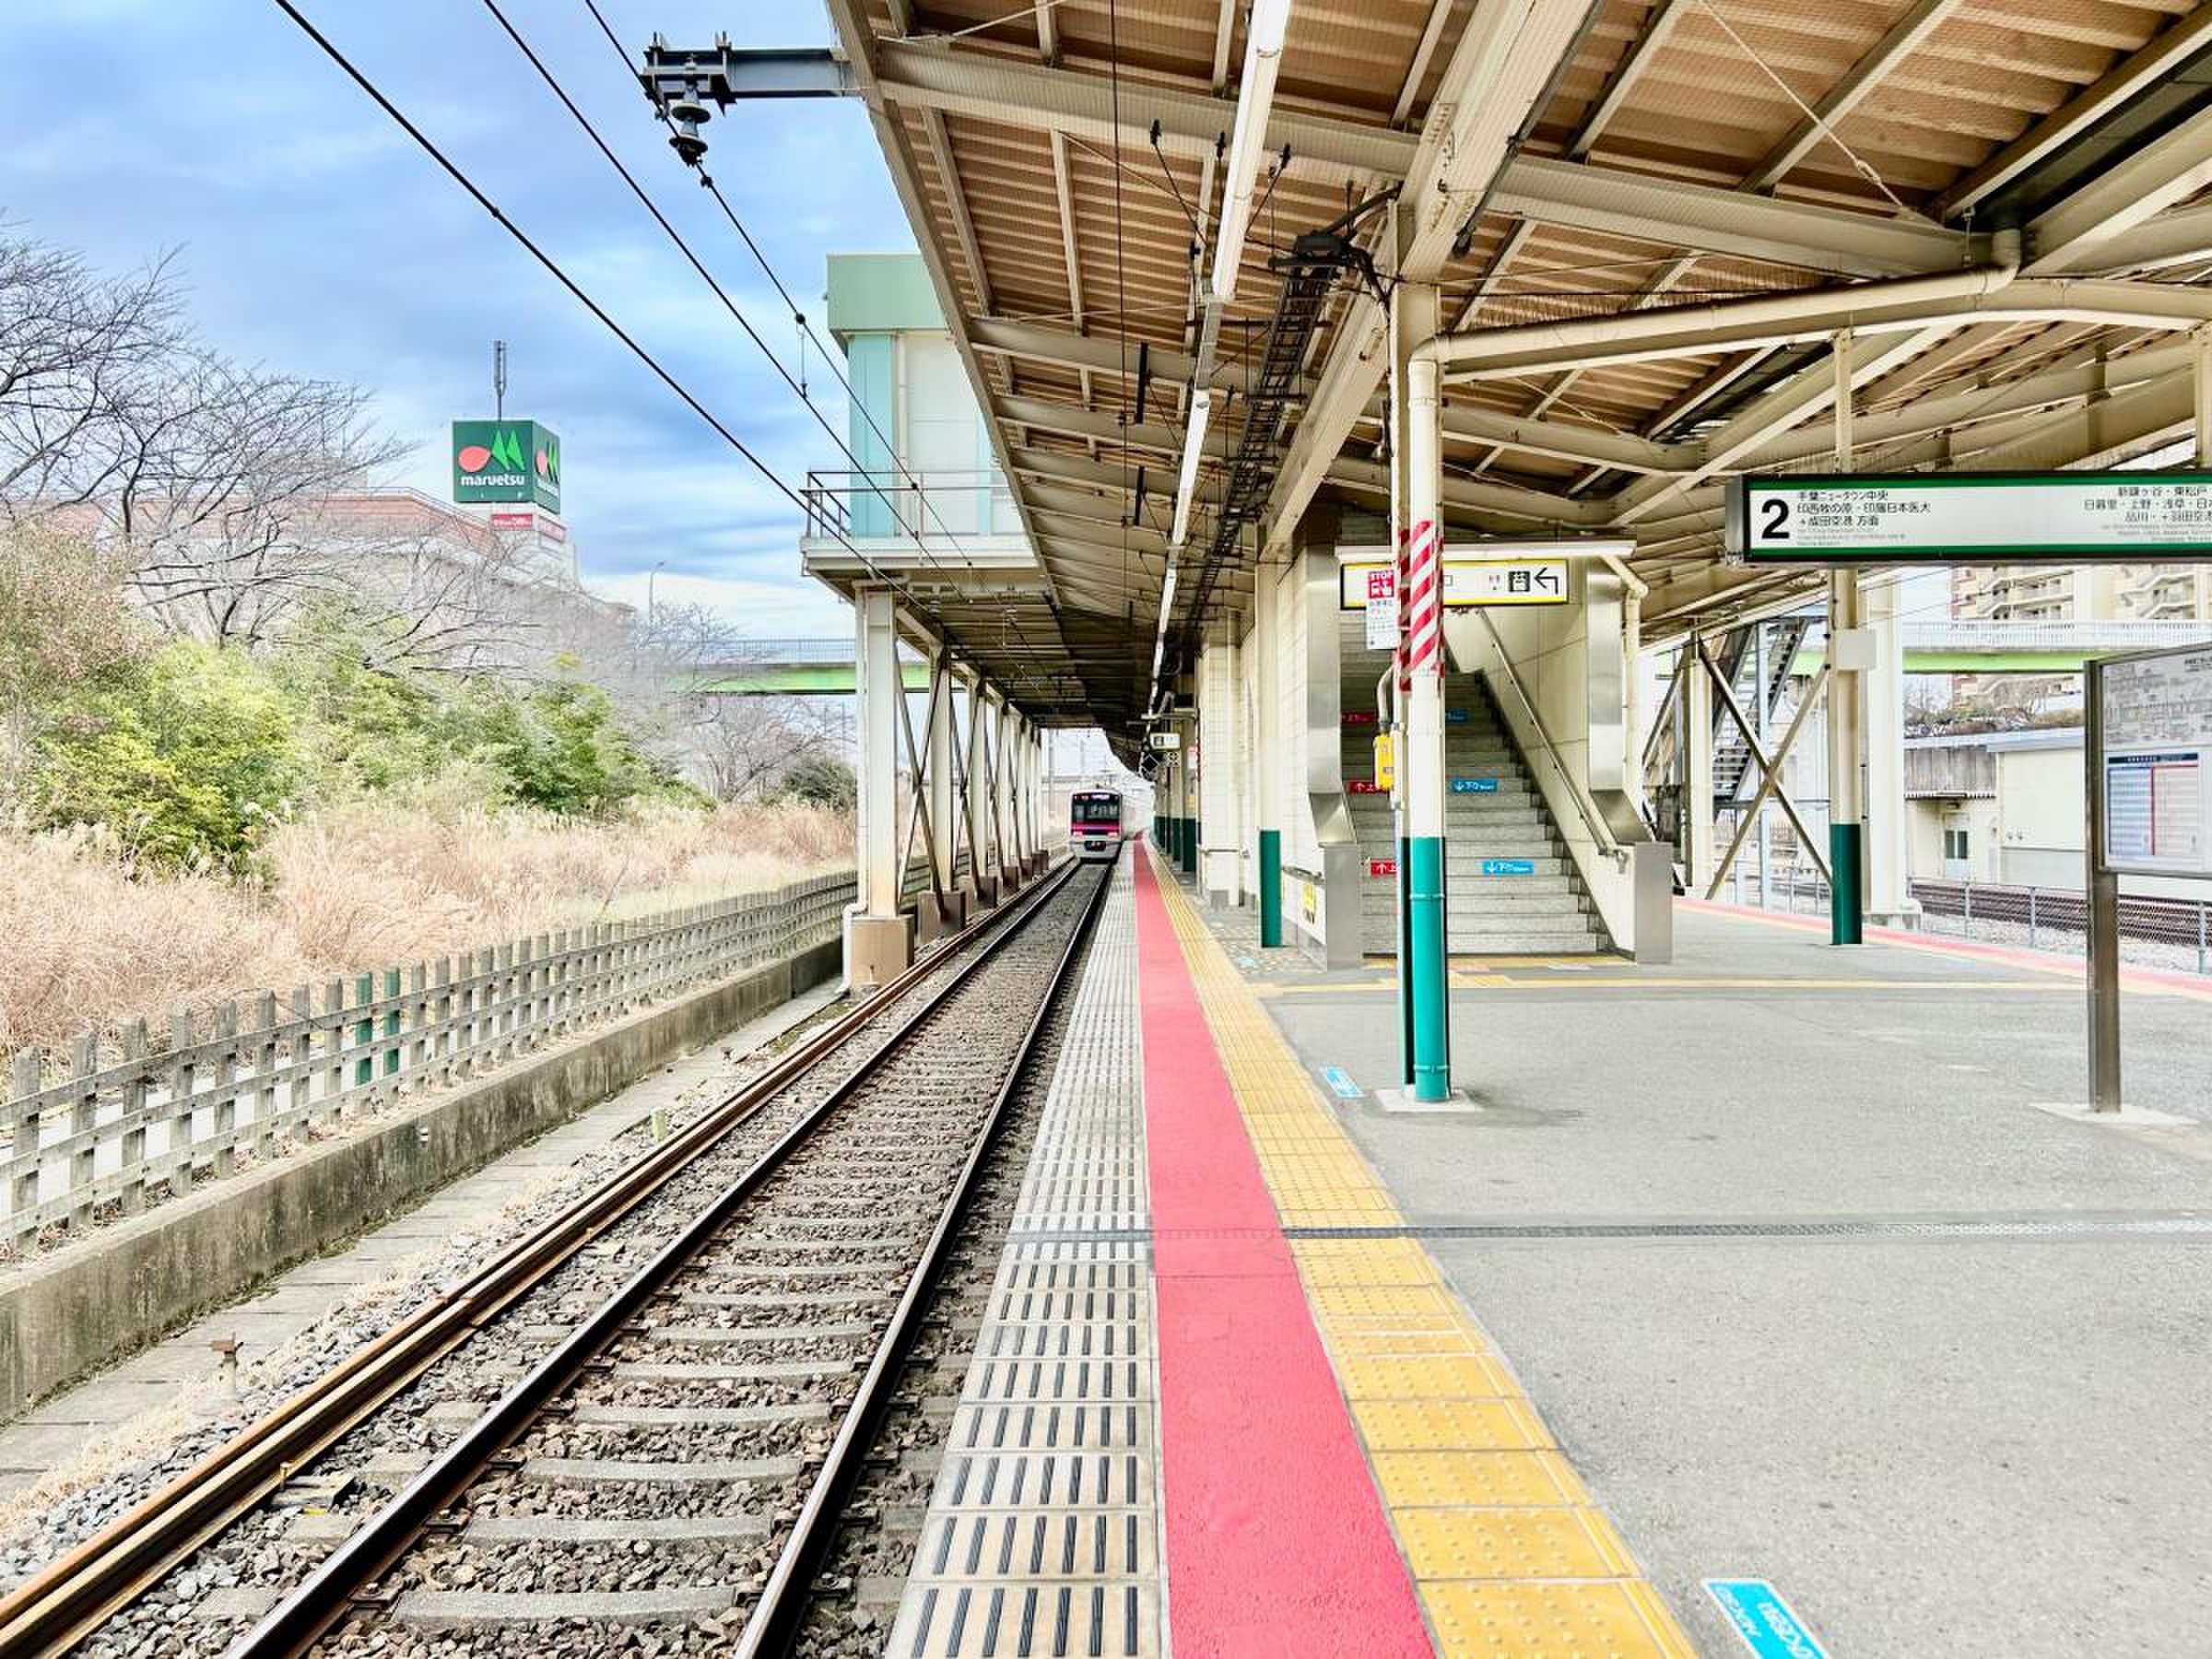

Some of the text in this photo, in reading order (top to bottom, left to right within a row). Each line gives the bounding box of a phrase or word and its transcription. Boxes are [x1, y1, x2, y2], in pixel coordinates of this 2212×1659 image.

[461, 474, 525, 487] maruetsu
[1761, 499, 1790, 539] 2
[1370, 571, 1393, 581] STOP
